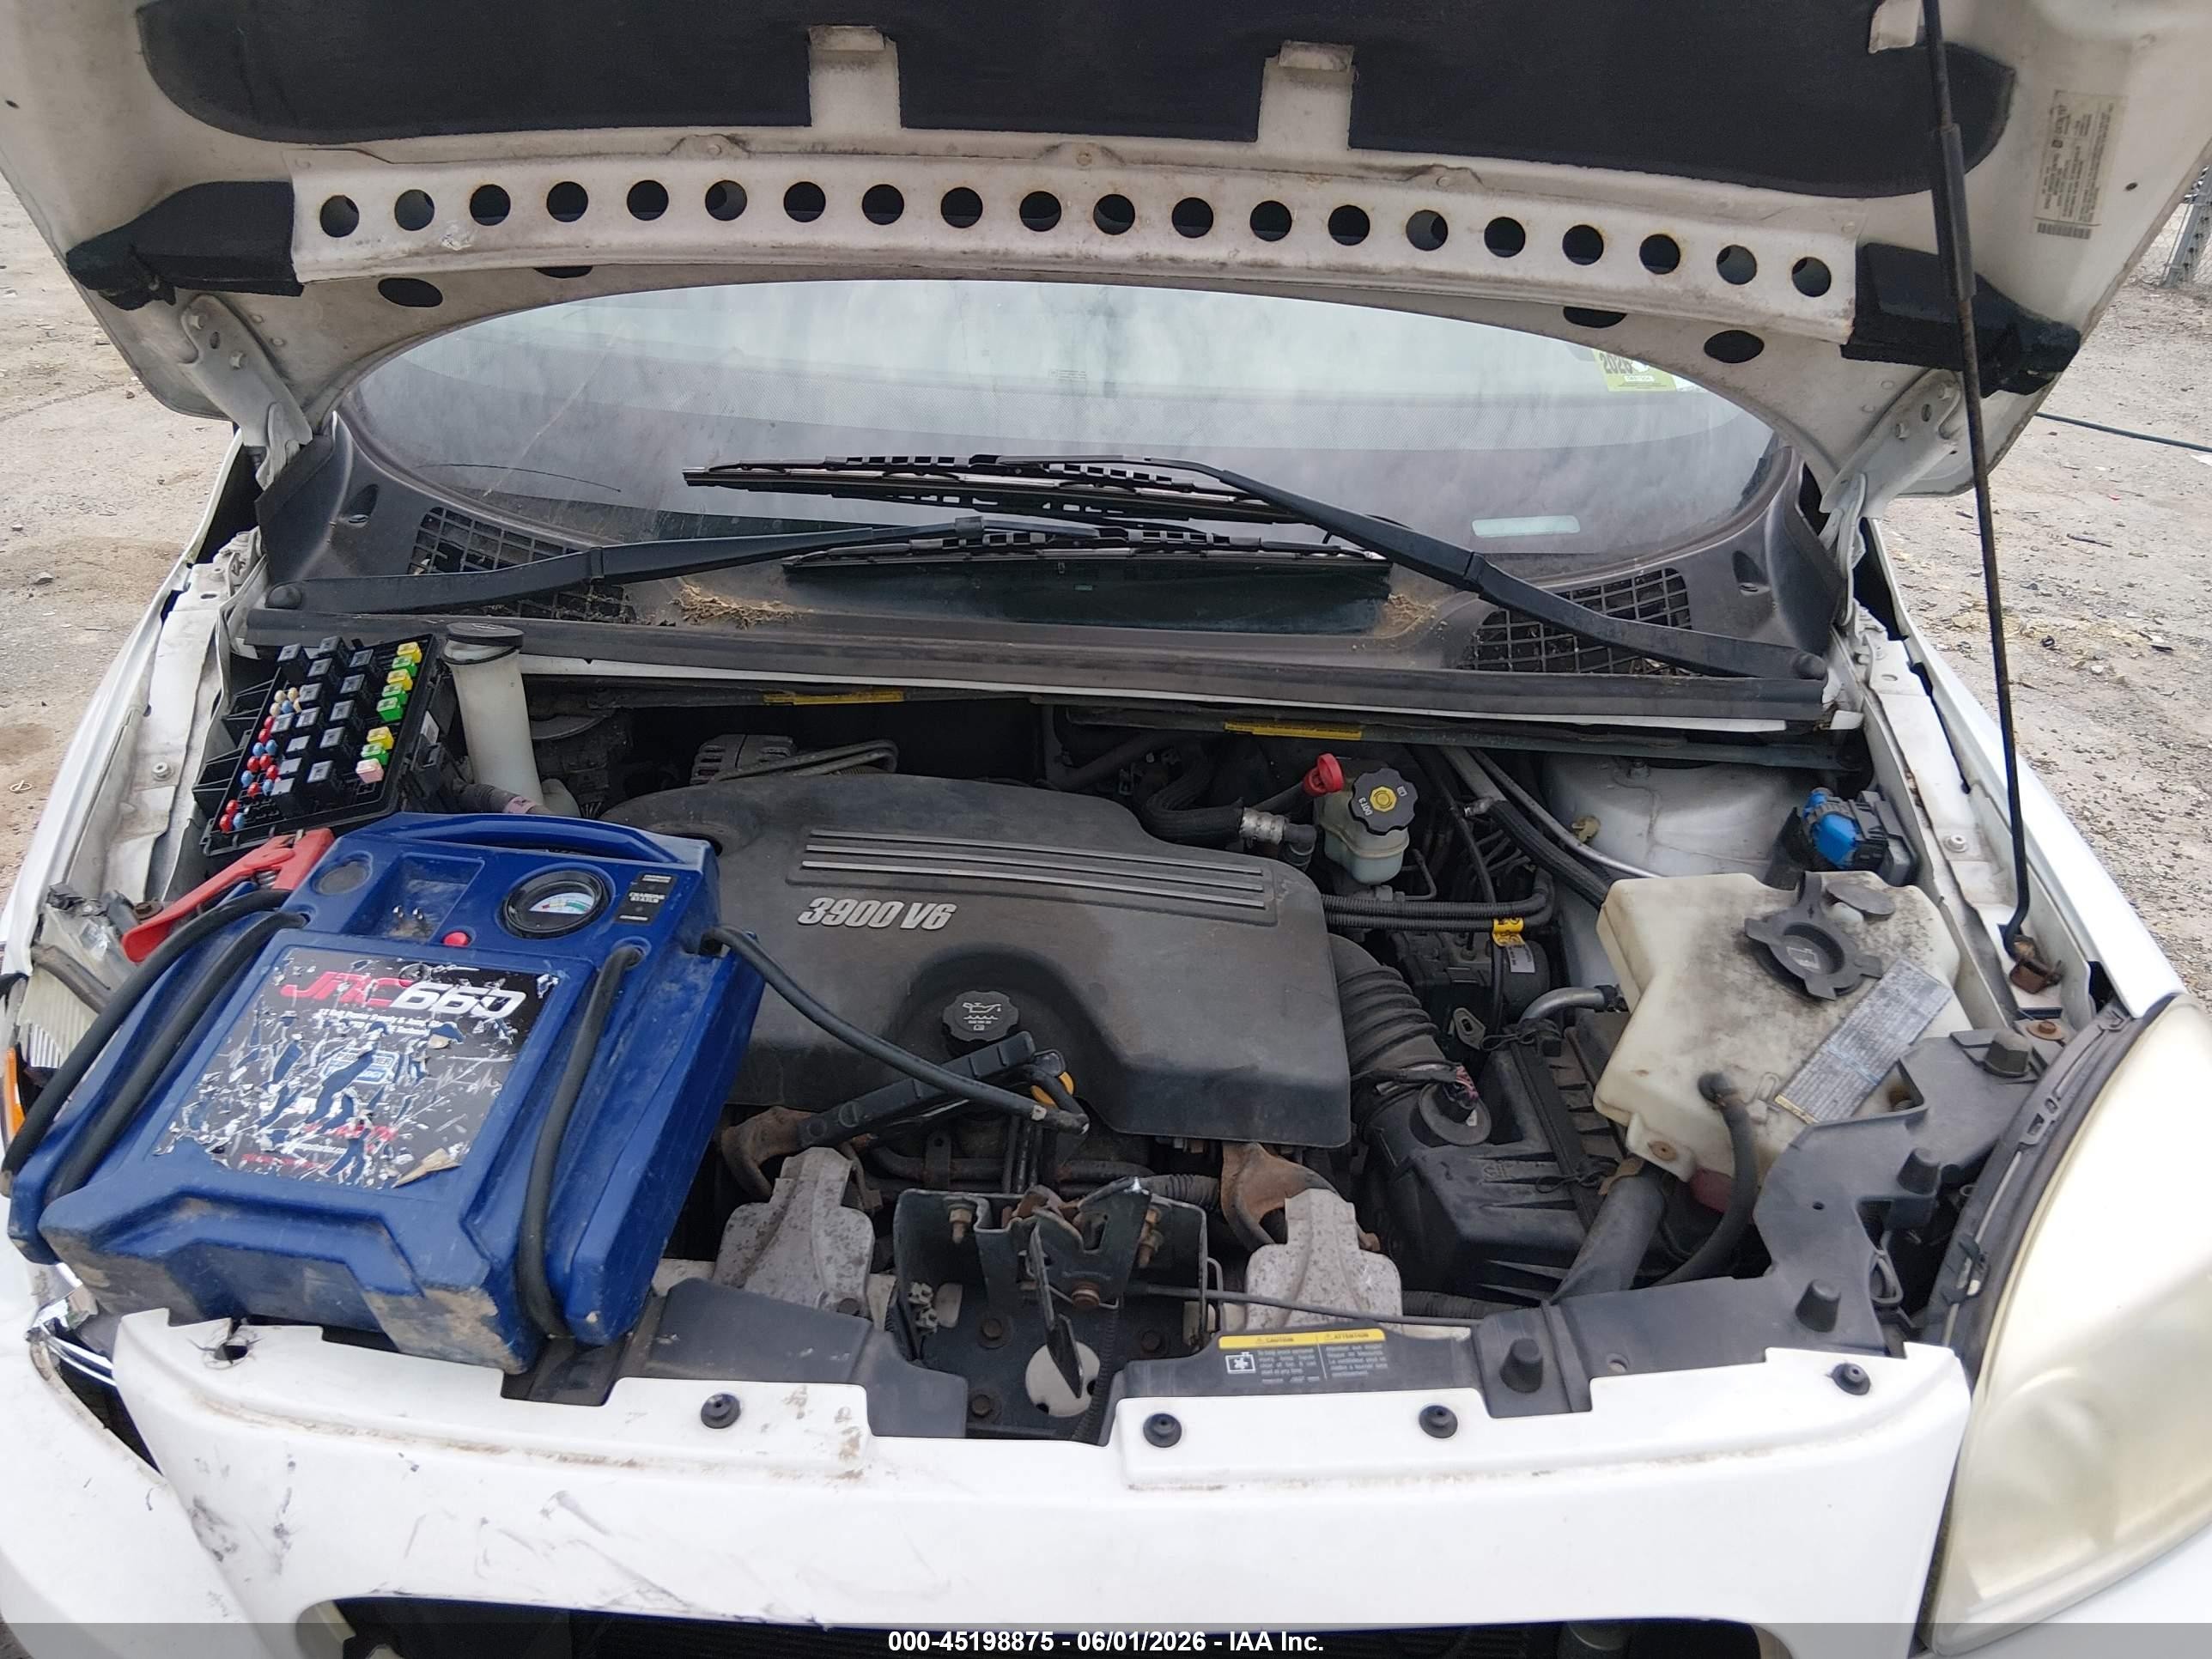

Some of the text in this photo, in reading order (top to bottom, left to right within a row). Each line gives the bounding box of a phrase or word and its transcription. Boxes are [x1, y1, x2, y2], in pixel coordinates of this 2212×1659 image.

[1358, 797, 1374, 817] DOT3
[797, 896, 957, 931] 3900 V6
